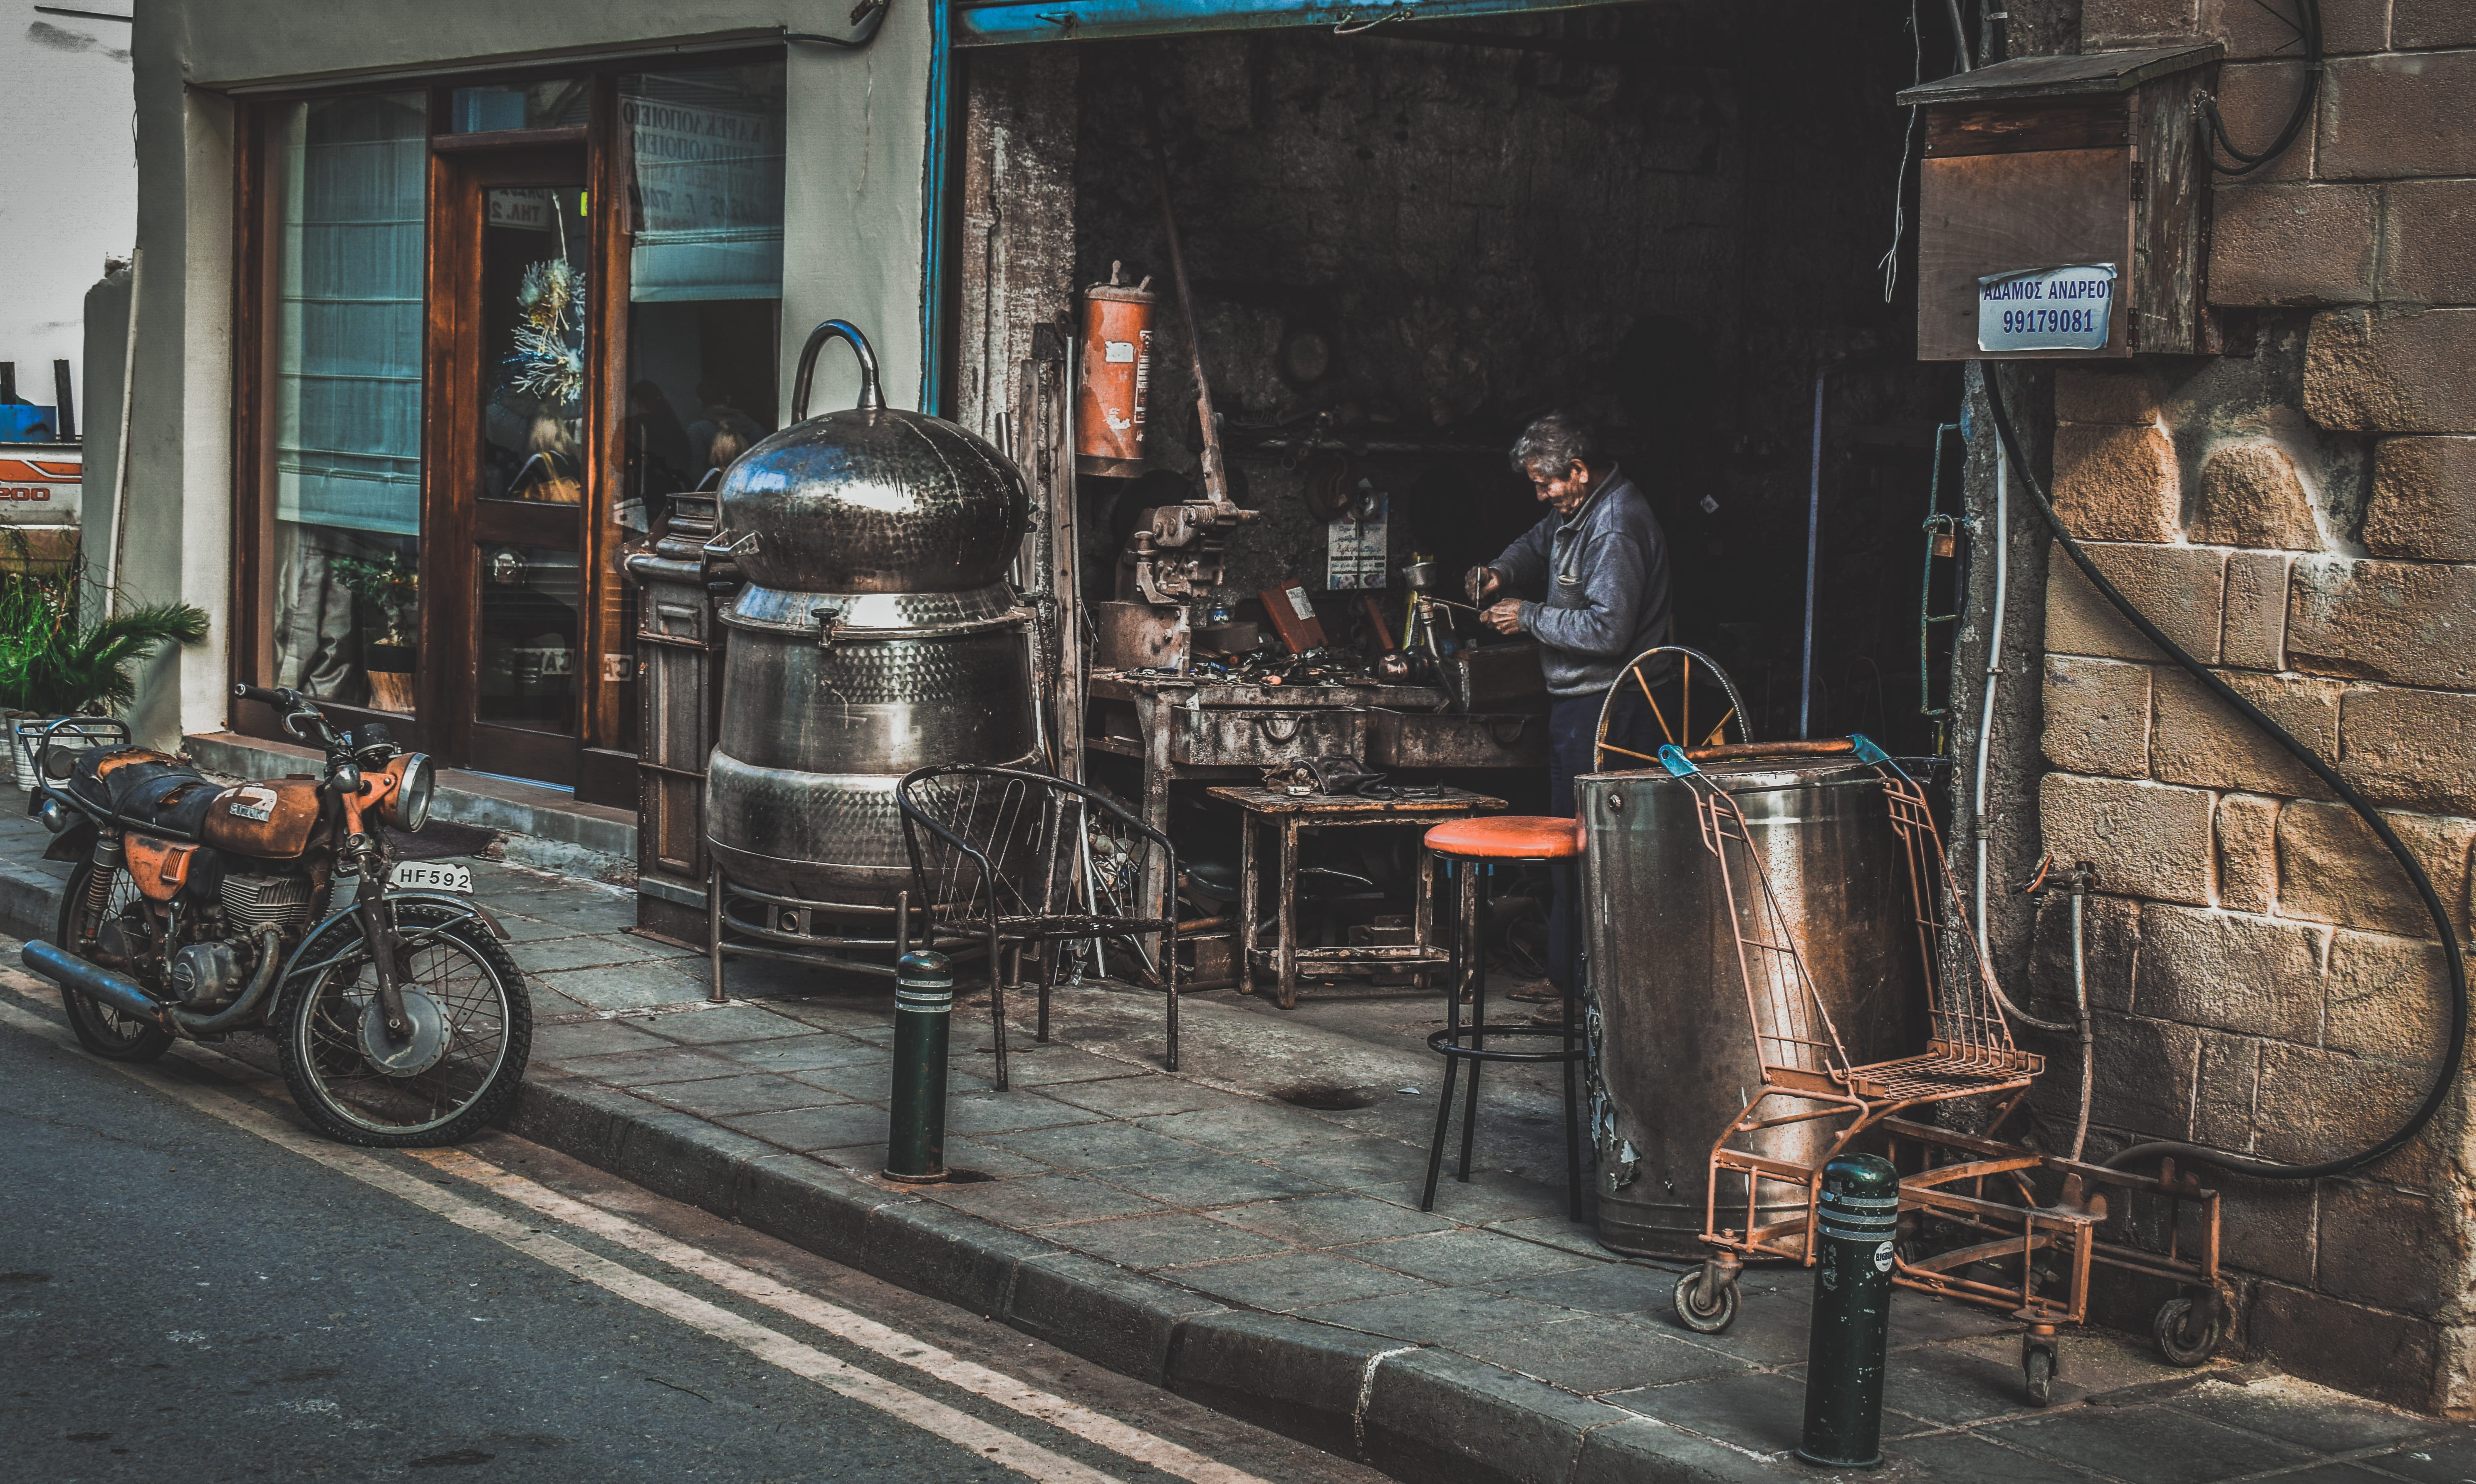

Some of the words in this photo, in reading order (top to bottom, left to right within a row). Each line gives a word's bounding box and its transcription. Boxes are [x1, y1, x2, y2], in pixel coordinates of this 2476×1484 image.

[1983, 281, 2043, 301] ΑΔΑΜΟΣ
[2003, 308, 2093, 334] 99179081
[230, 802, 269, 823] SUZUKI
[400, 869, 470, 889] HF592
